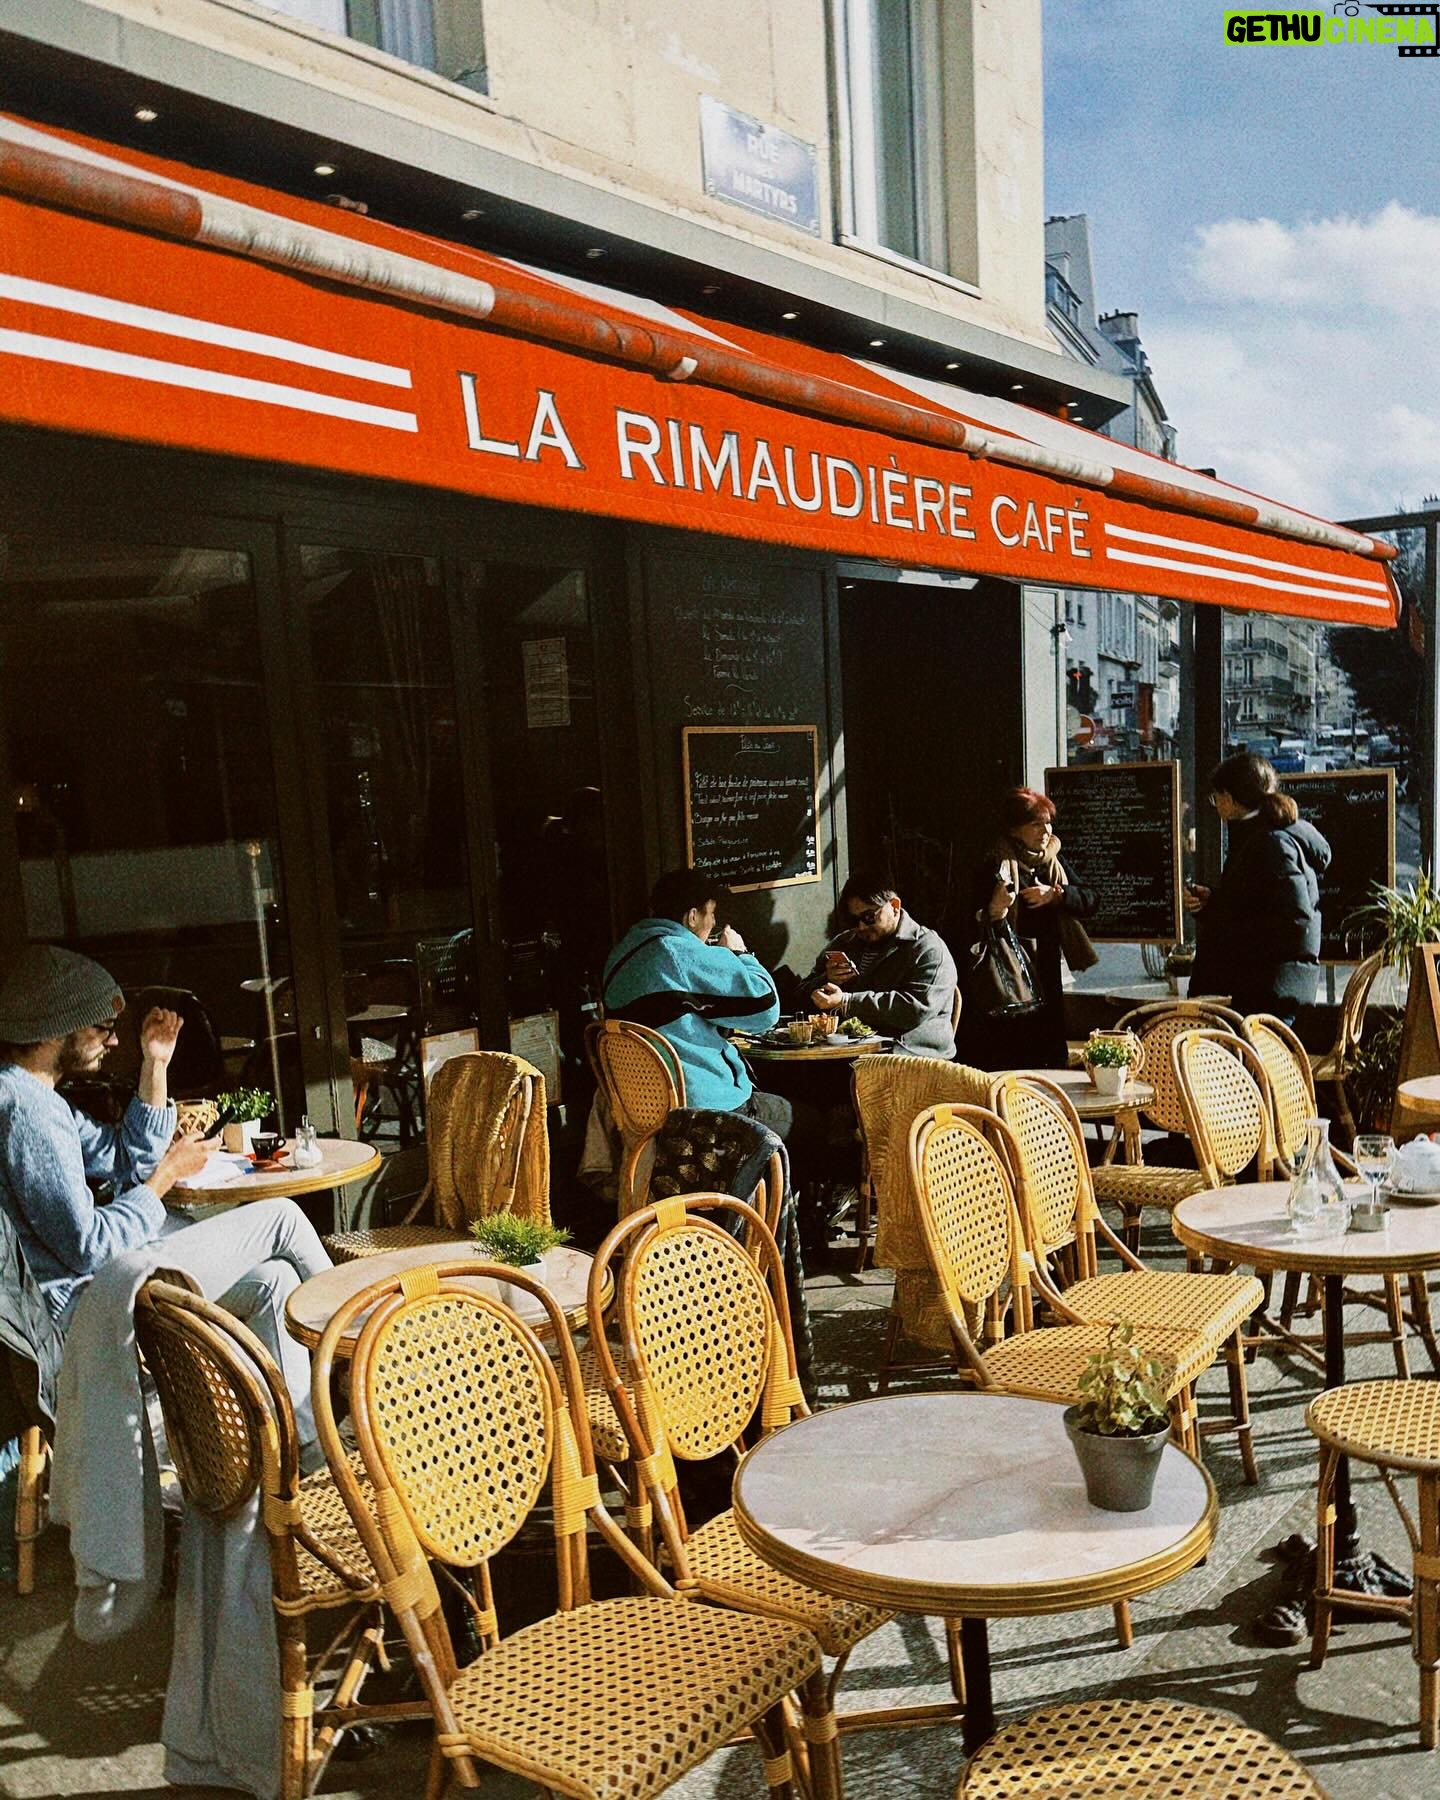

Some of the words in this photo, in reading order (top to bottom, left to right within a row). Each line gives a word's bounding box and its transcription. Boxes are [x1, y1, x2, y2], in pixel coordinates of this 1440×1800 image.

[747, 134, 779, 163] RUE
[456, 370, 586, 471] LA
[615, 406, 977, 540] RIMAUDIÈRE
[989, 497, 1093, 558] CAFÉ
